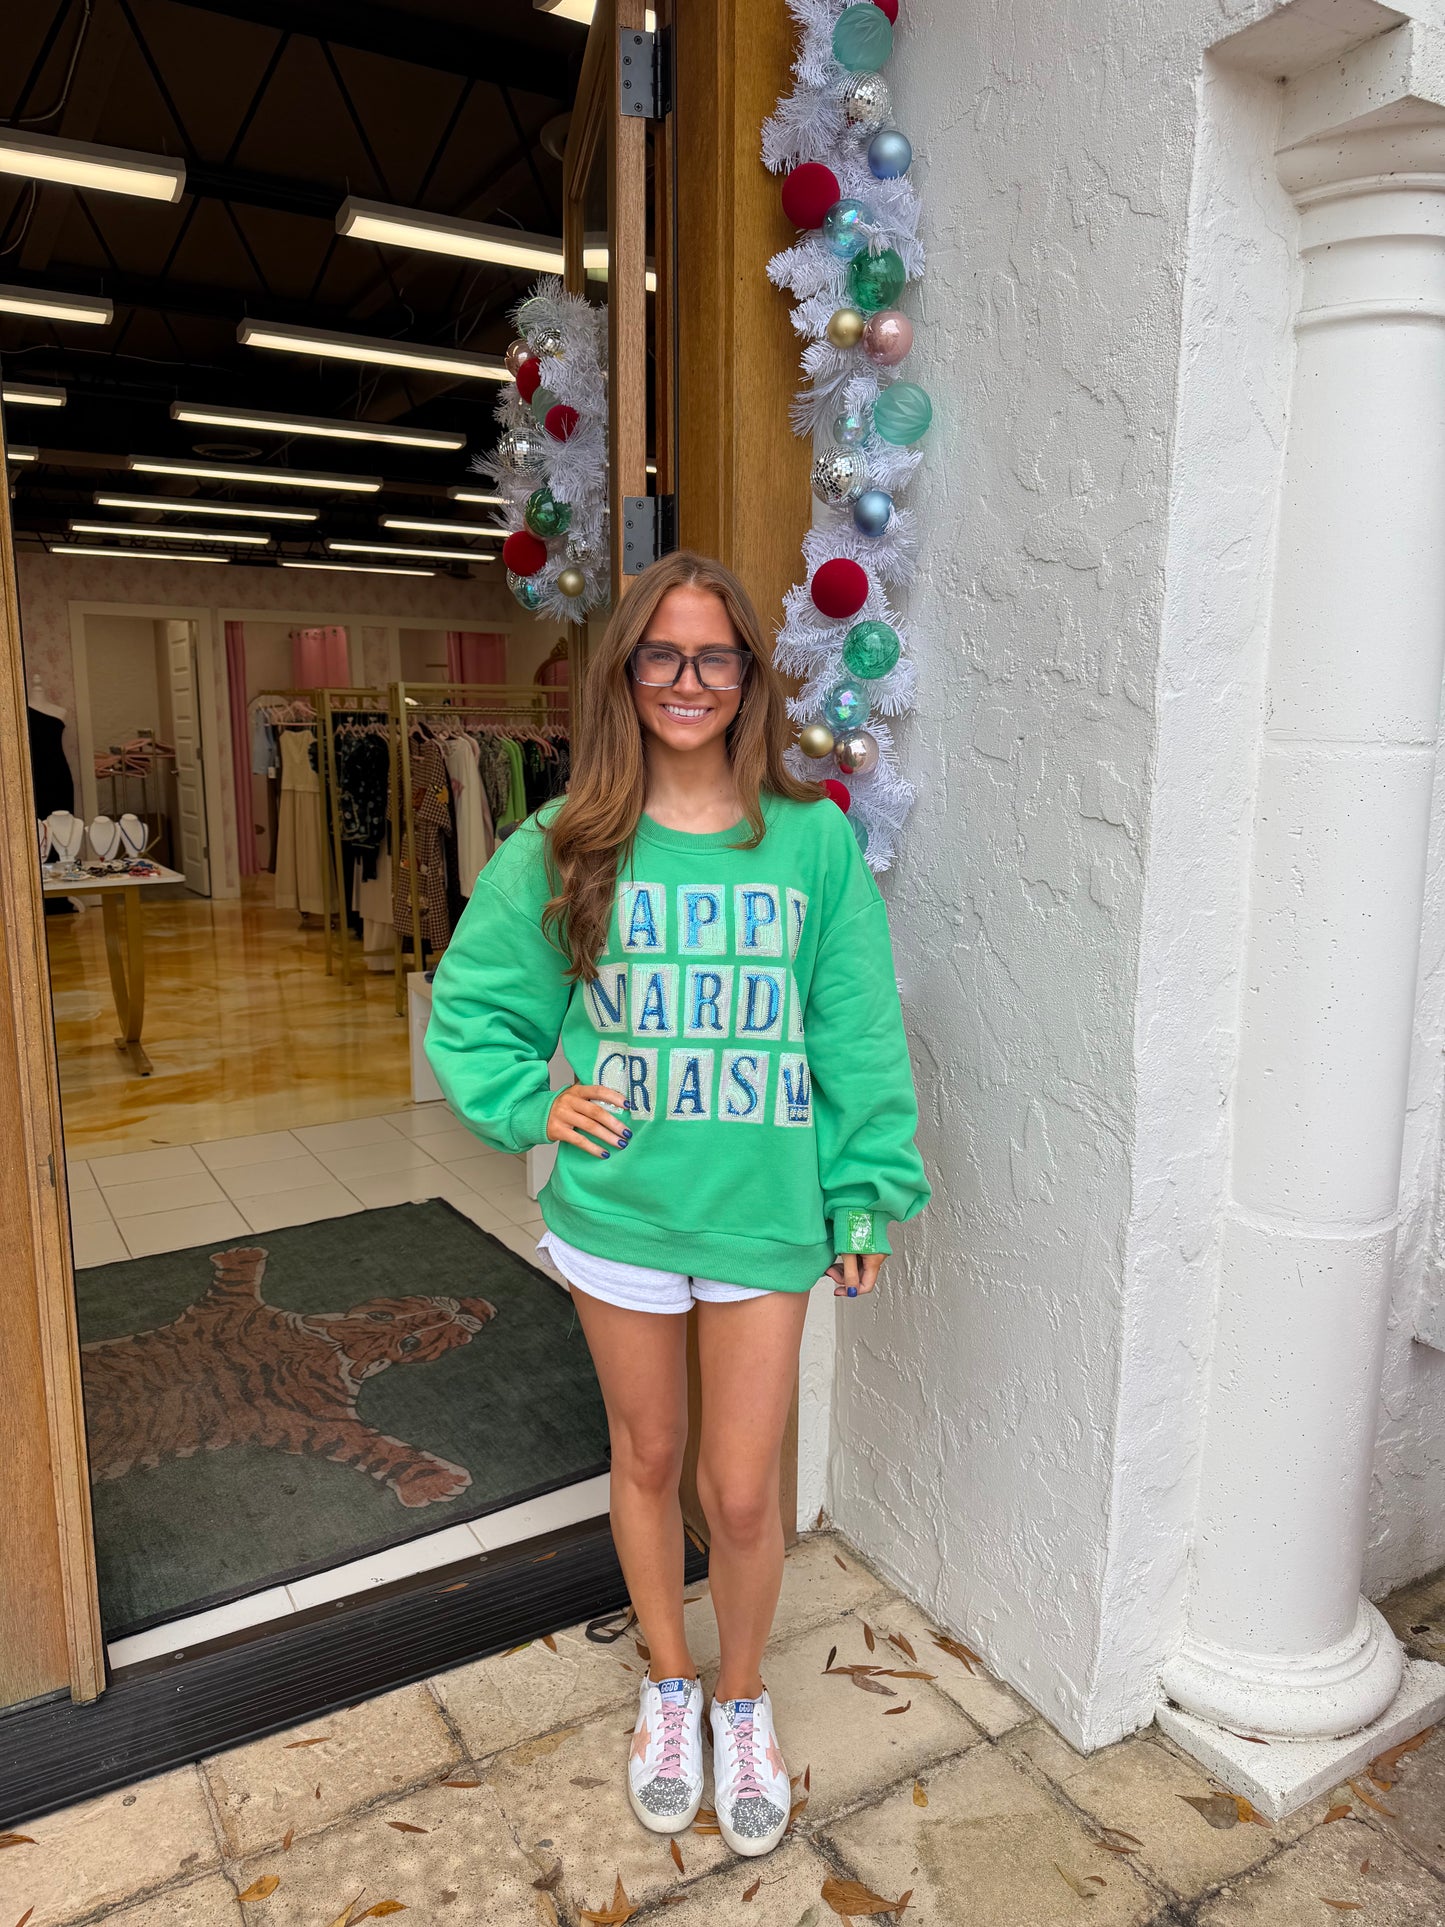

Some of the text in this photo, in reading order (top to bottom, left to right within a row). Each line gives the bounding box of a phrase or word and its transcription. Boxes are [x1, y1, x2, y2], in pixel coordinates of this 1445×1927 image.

[599, 889, 806, 954] APP
[590, 973, 804, 1033] MARD
[739, 1702, 754, 1713] GGD
